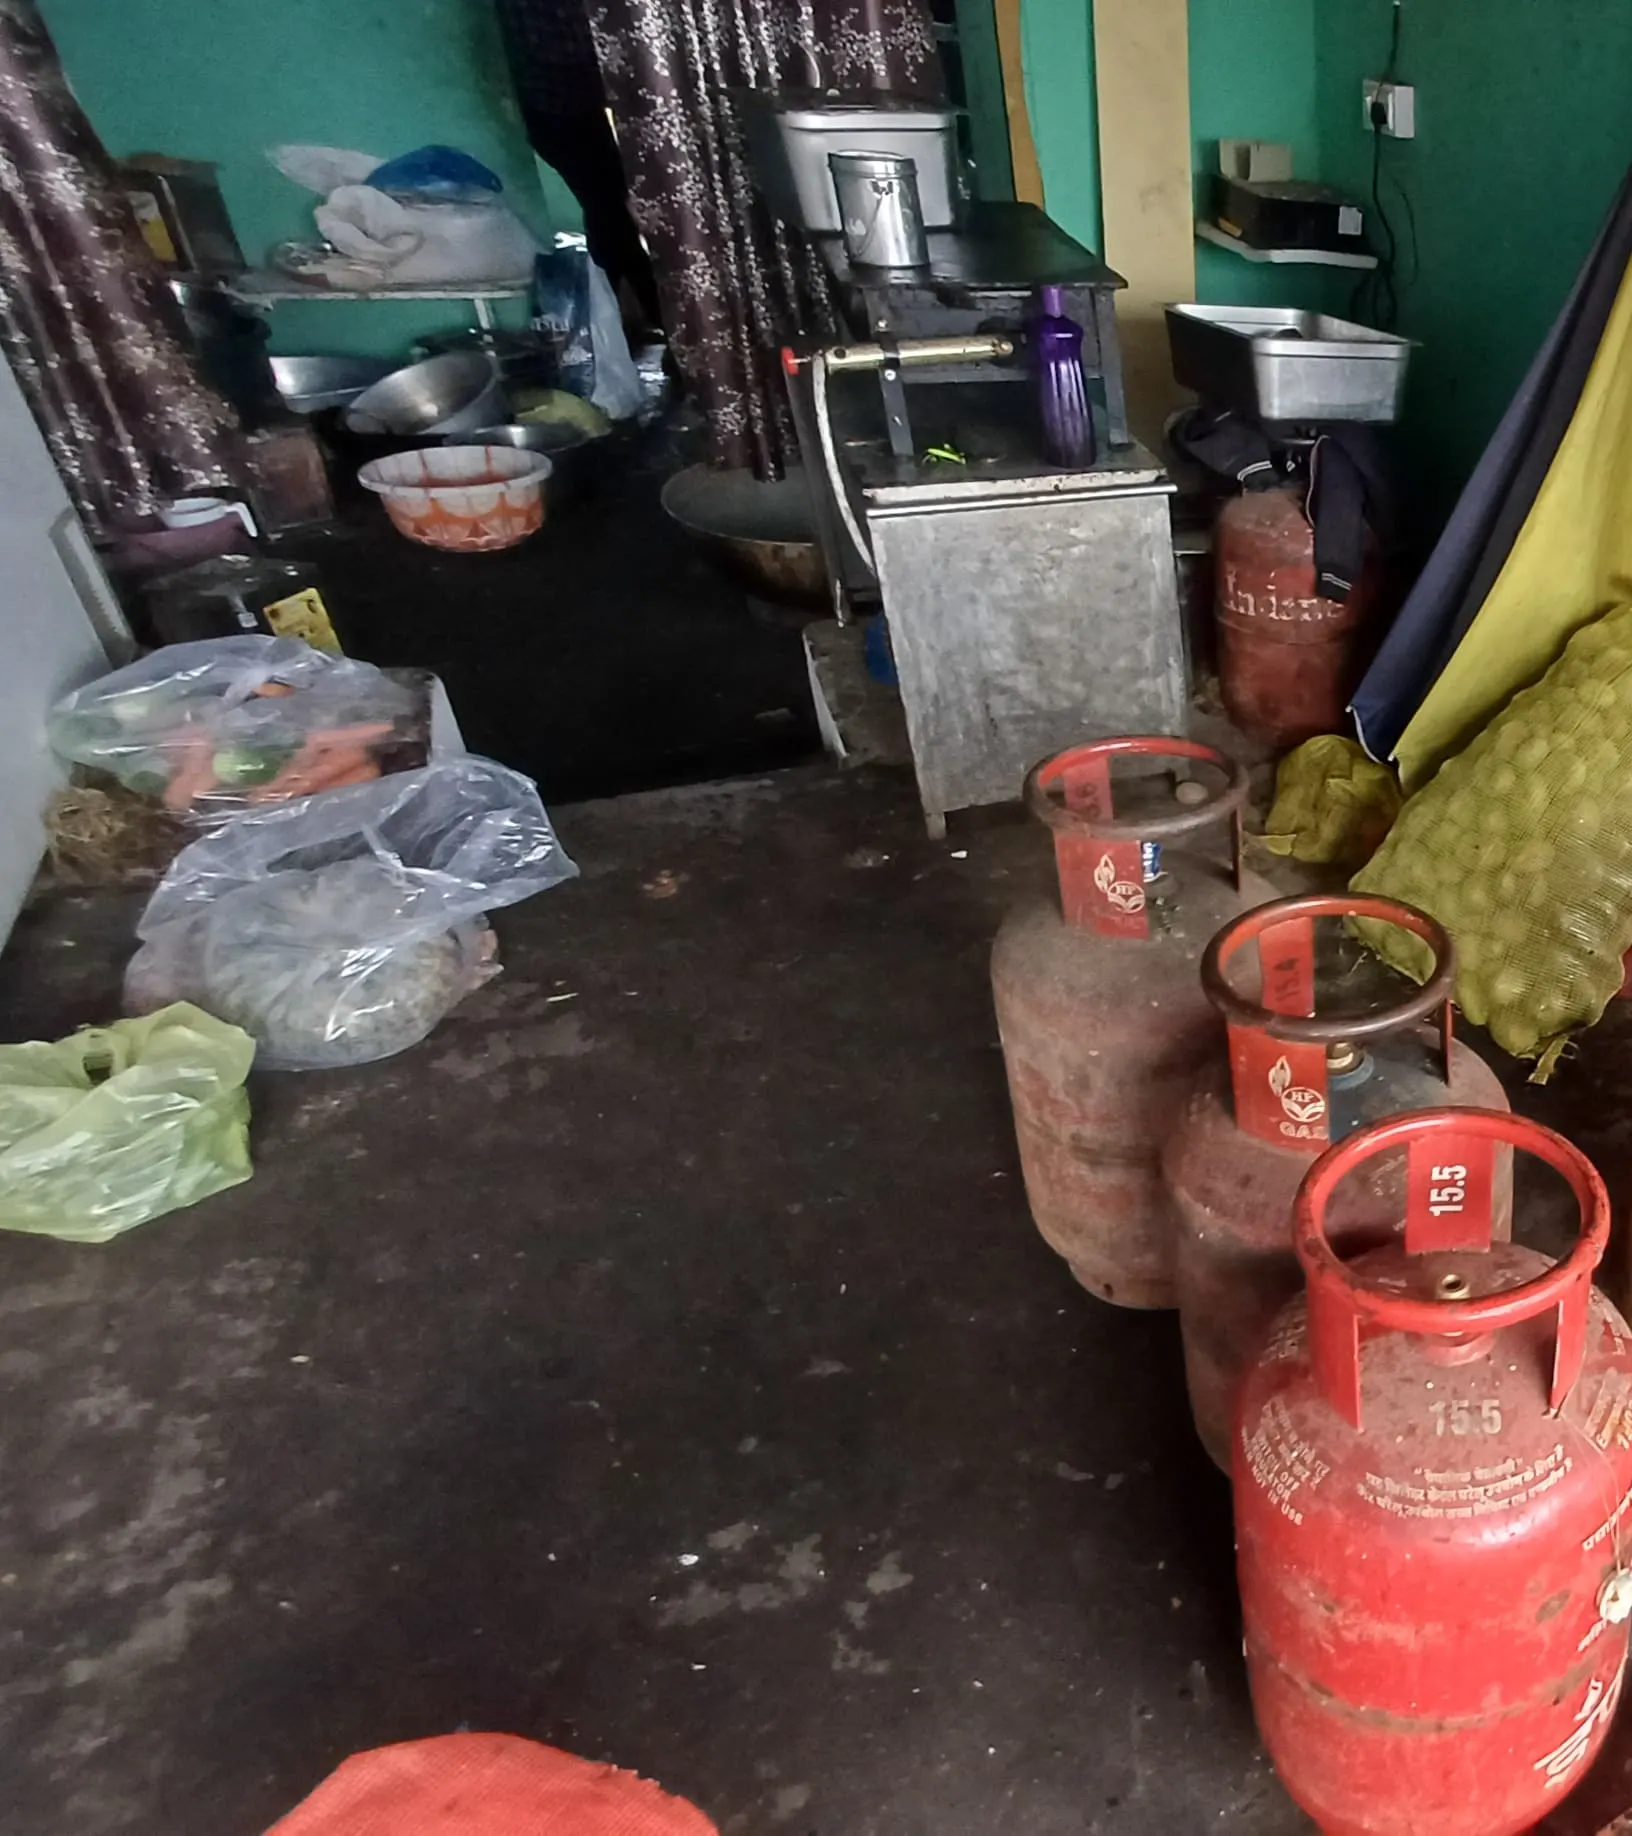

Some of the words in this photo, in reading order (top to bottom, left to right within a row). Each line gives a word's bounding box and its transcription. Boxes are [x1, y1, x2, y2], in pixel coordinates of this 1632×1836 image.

[1279, 1121, 1329, 1140] GAS
[1429, 1164, 1467, 1217] 15.5
[1429, 1399, 1502, 1437] 15.5
